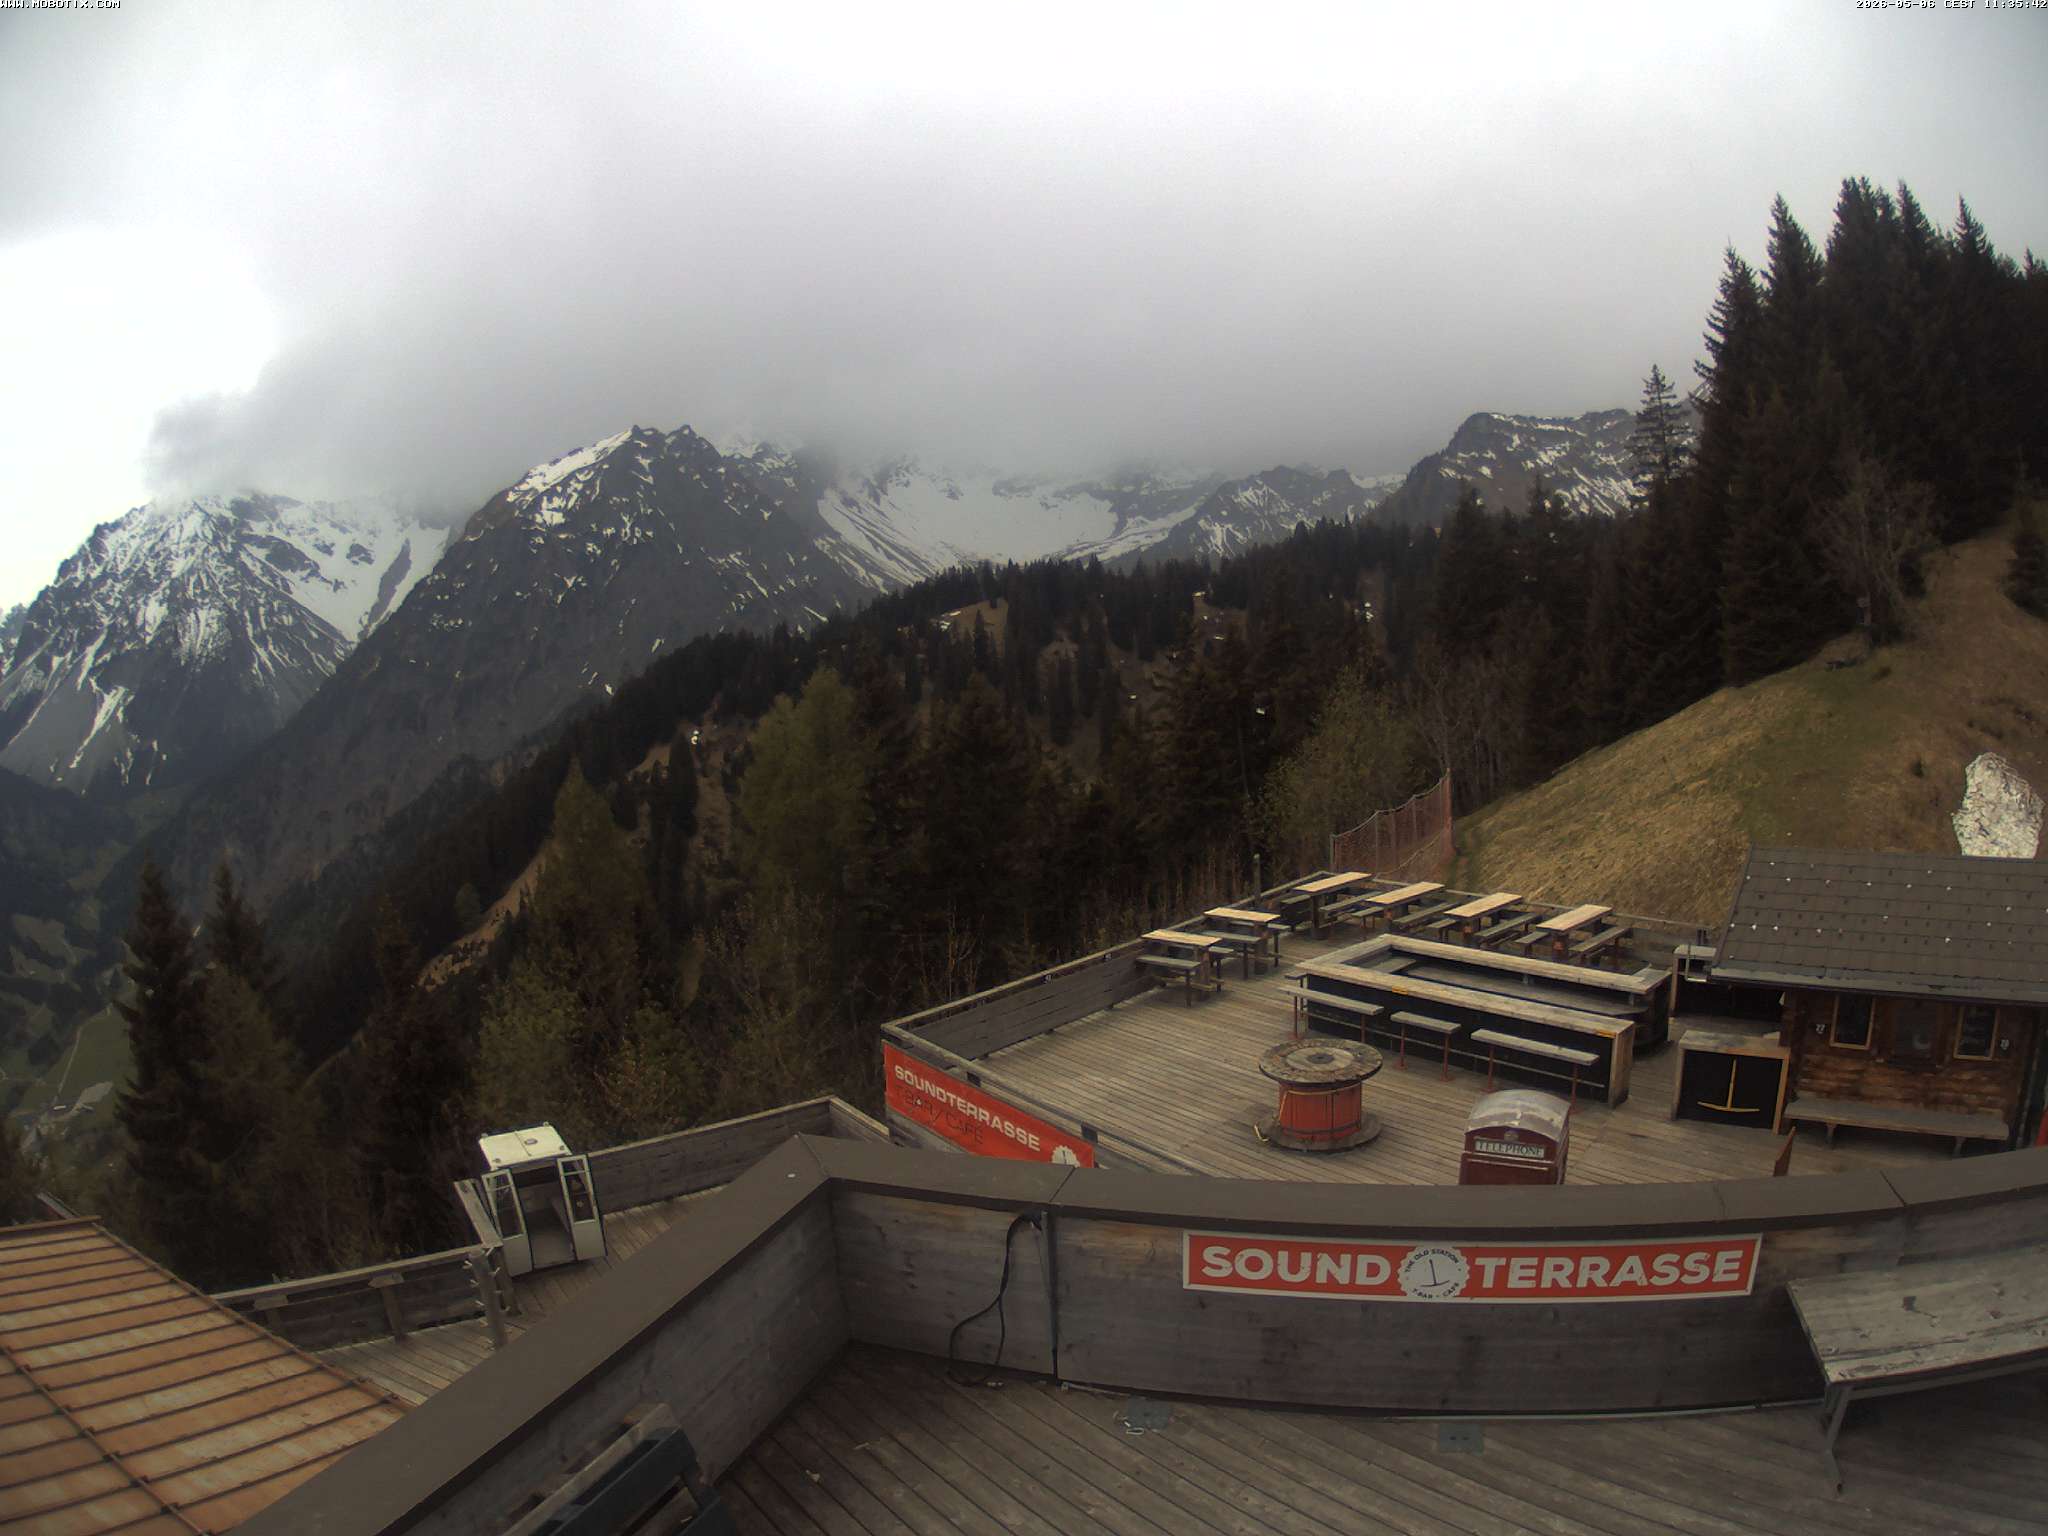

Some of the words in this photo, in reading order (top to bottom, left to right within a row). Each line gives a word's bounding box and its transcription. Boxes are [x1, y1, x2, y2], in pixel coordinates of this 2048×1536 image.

[895, 1065, 1041, 1152] SOUNDTERRASSE
[1478, 1141, 1541, 1156] TELEPHONE
[1202, 1246, 1392, 1286] SOUND
[1476, 1249, 1744, 1289] TERRASSE
